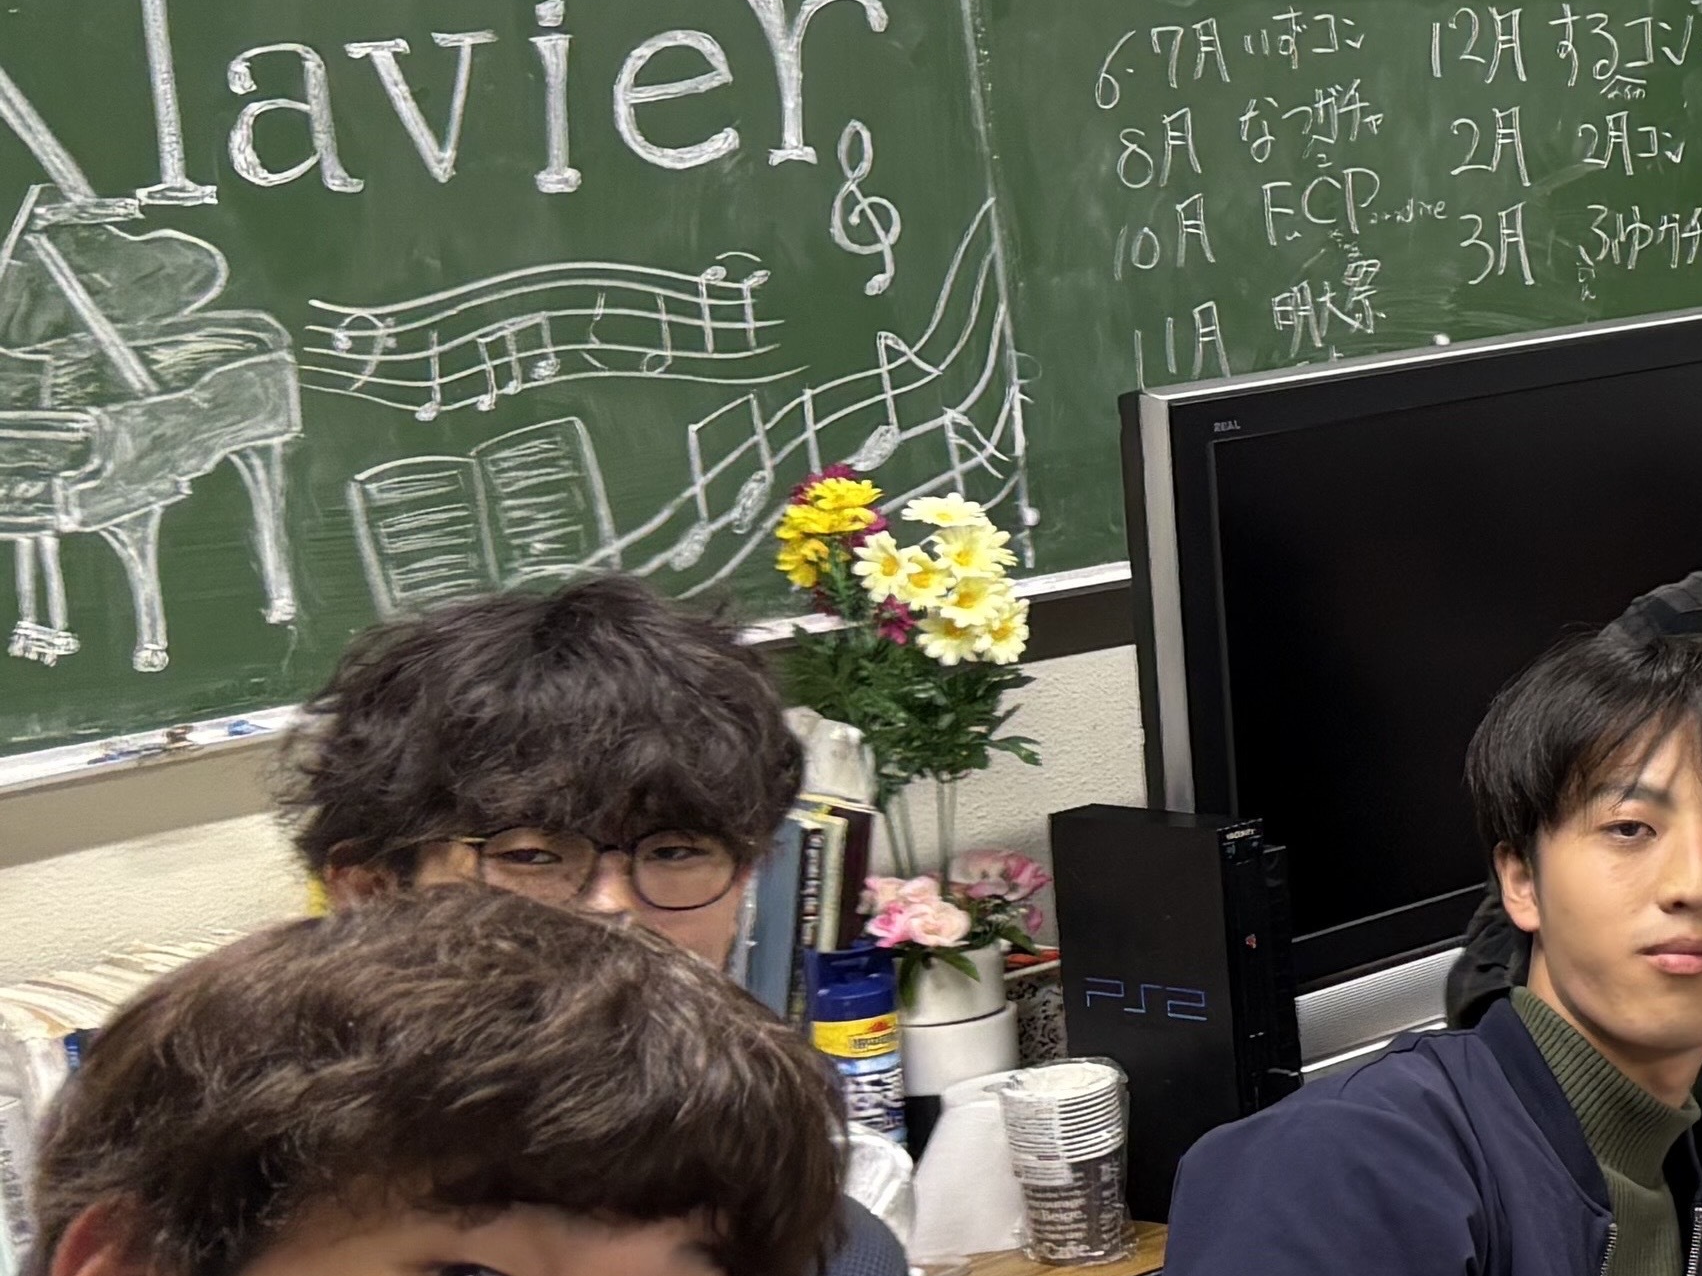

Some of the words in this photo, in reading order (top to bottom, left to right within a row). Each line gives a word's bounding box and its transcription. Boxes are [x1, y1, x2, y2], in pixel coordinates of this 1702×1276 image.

[1432, 6, 1528, 84] 12月
[1117, 107, 1202, 188] 8月
[1450, 106, 1531, 187] 2月
[1114, 193, 1216, 281] 10月
[1459, 201, 1535, 285] 3月
[1134, 301, 1231, 391] 11月
[1085, 977, 1208, 1021] PS2
